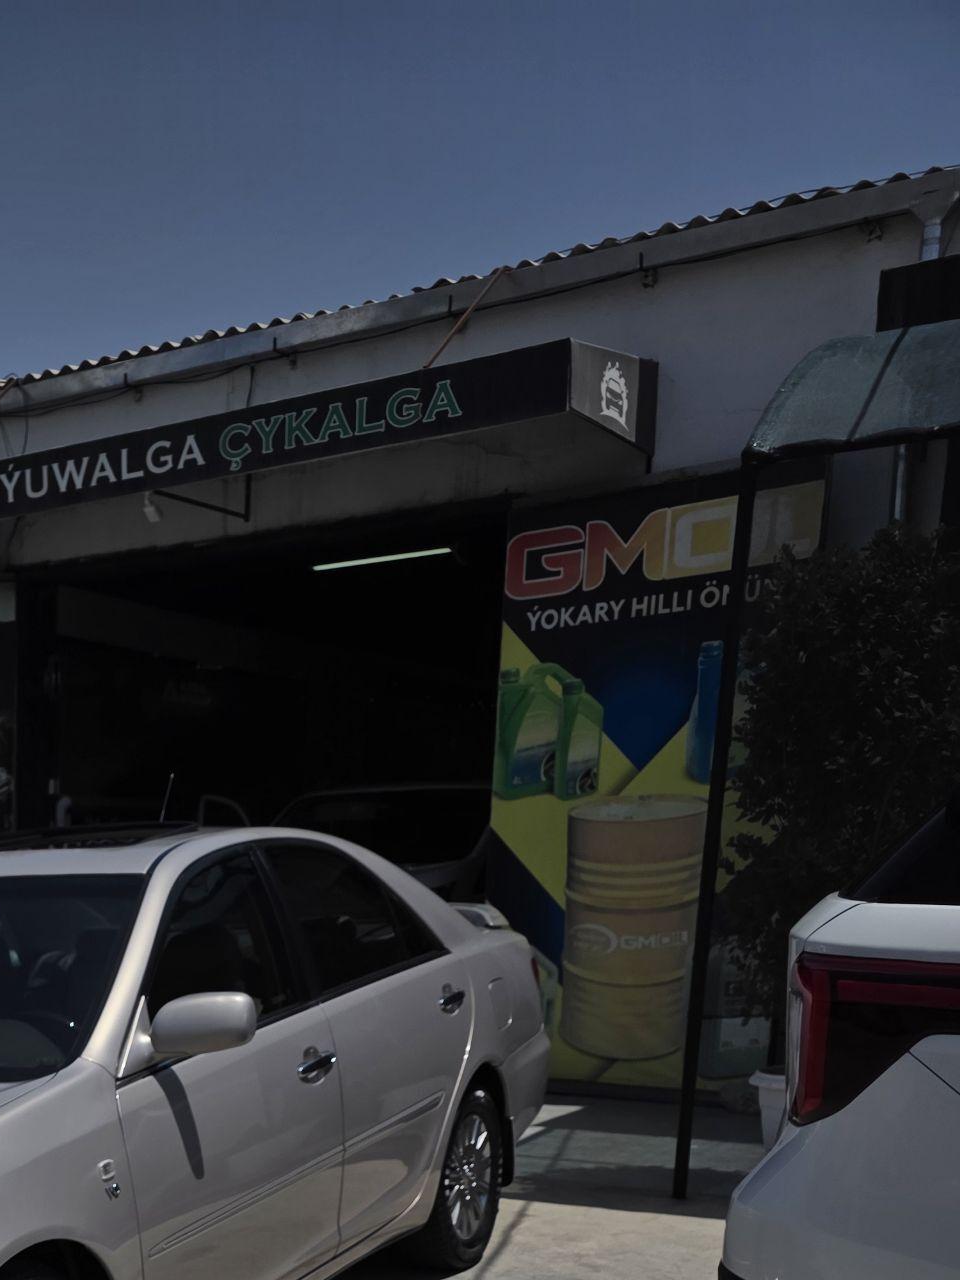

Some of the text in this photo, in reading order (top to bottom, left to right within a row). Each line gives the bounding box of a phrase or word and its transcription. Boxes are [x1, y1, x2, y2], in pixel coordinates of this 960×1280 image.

[219, 379, 463, 472] ÇYKALGA
[526, 599, 627, 632] ÝOKARY
[630, 589, 693, 619] HILLI
